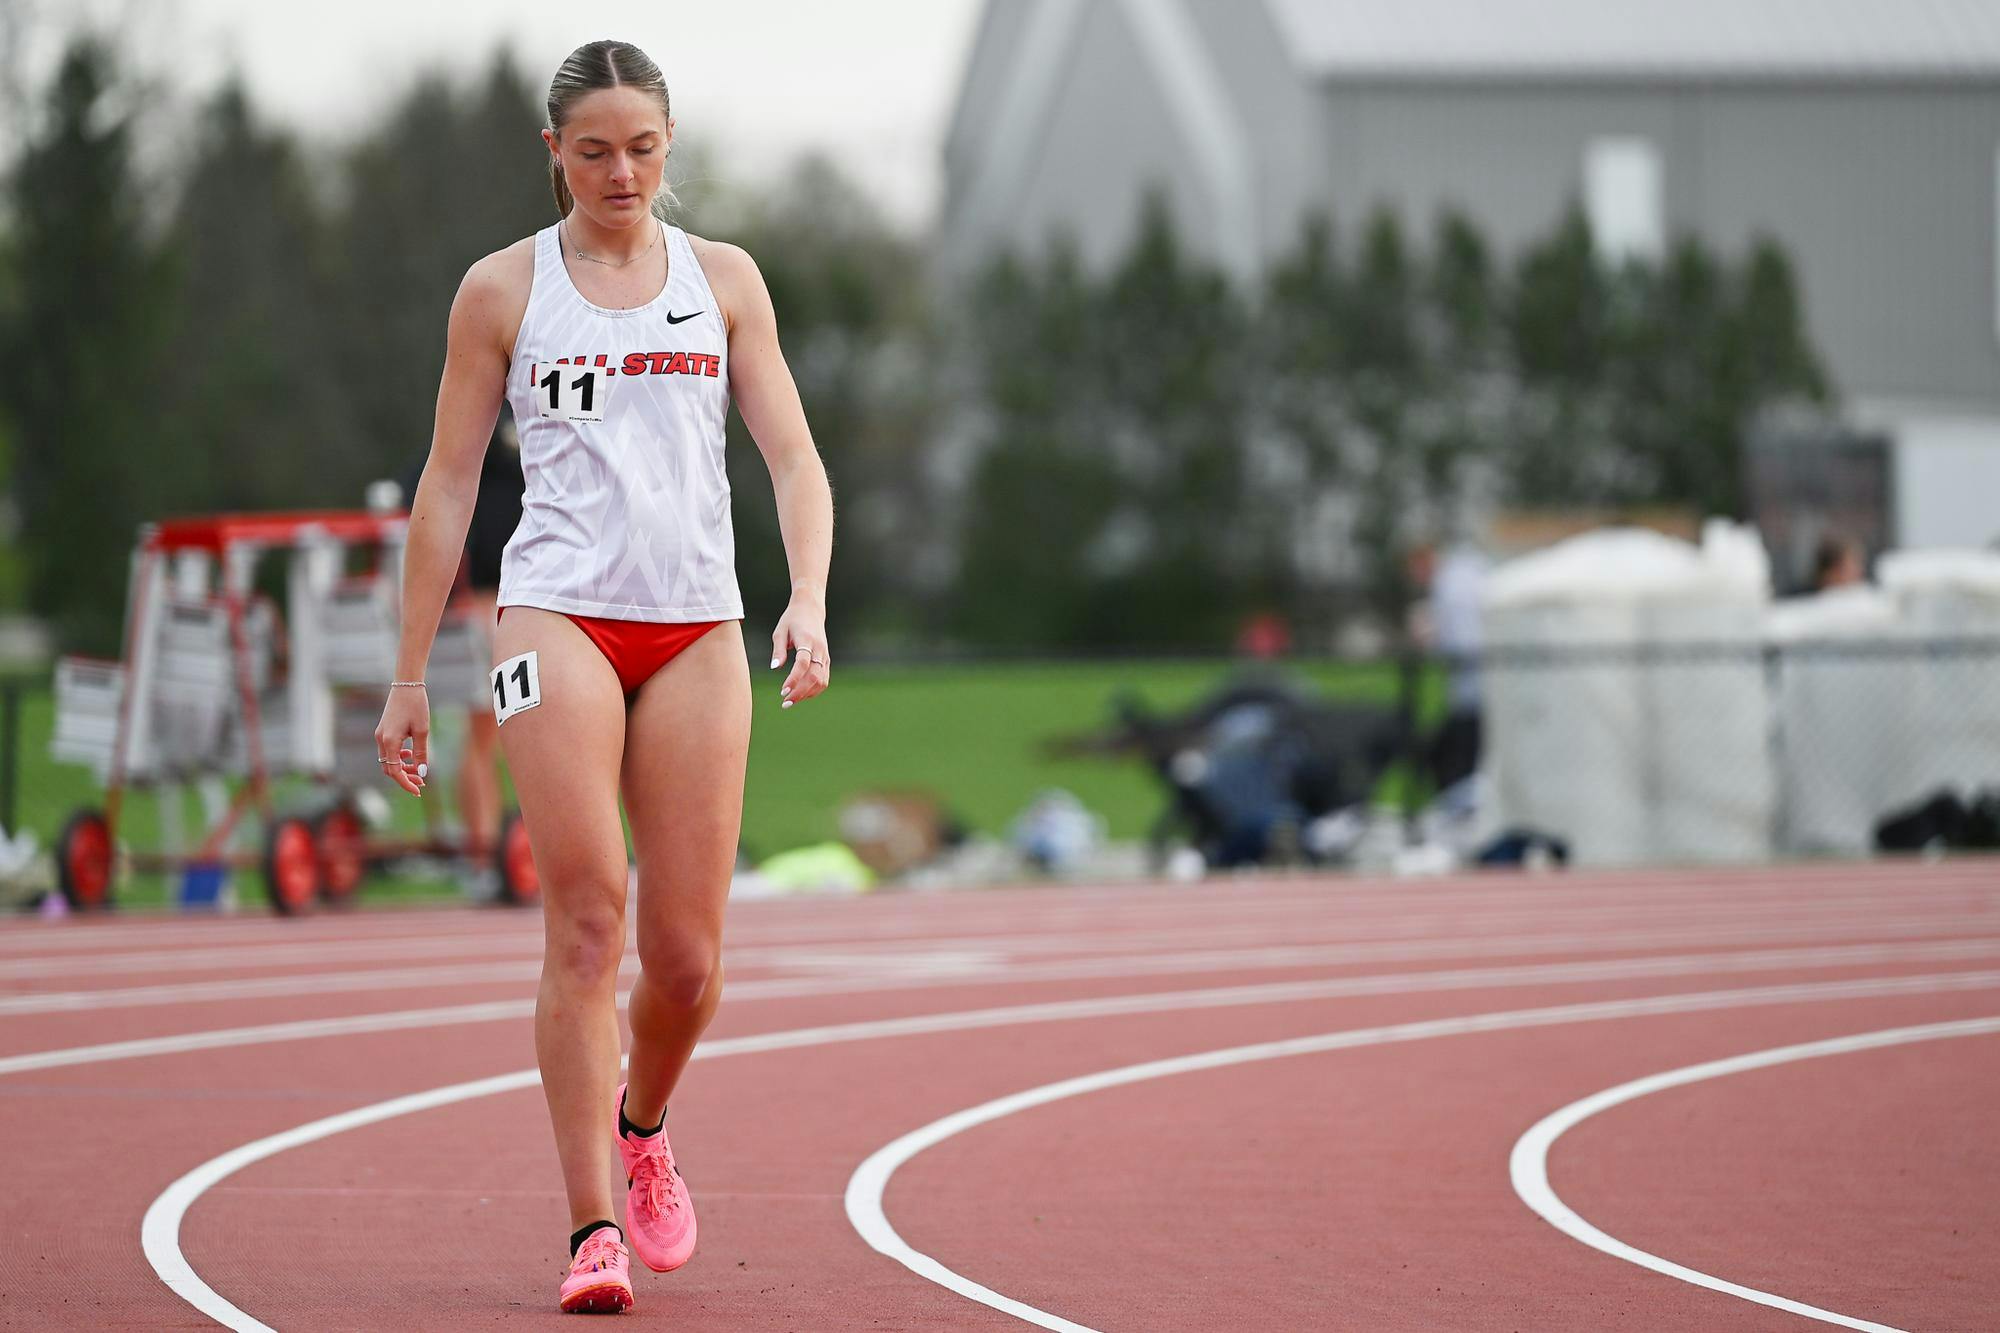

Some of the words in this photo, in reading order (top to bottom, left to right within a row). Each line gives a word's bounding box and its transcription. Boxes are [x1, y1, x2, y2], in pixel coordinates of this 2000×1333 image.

[621, 352, 720, 378] STATE
[540, 370, 595, 411] 11
[494, 660, 530, 710] 11
